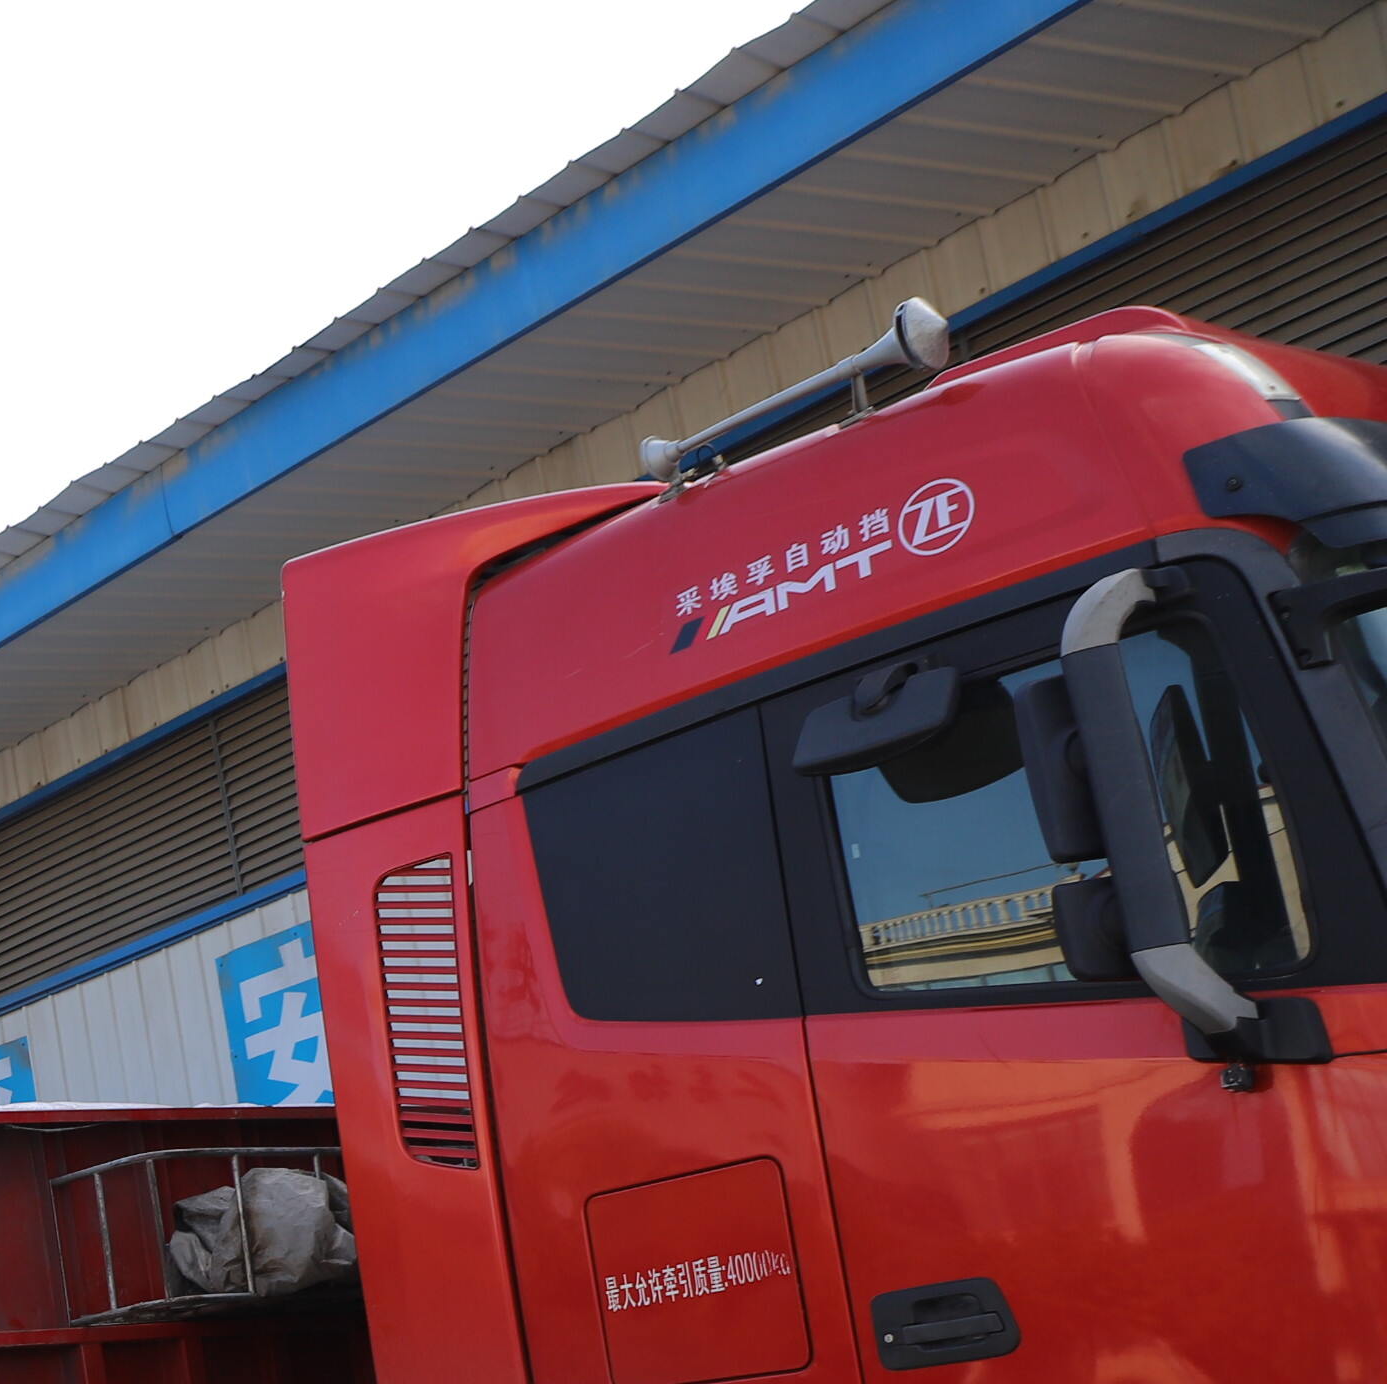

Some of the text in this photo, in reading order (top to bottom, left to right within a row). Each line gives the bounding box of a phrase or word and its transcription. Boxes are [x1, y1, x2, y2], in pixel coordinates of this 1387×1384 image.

[677, 508, 891, 617] 采埃孚自动挡
[901, 482, 971, 551] ZF
[718, 538, 894, 636] AMT
